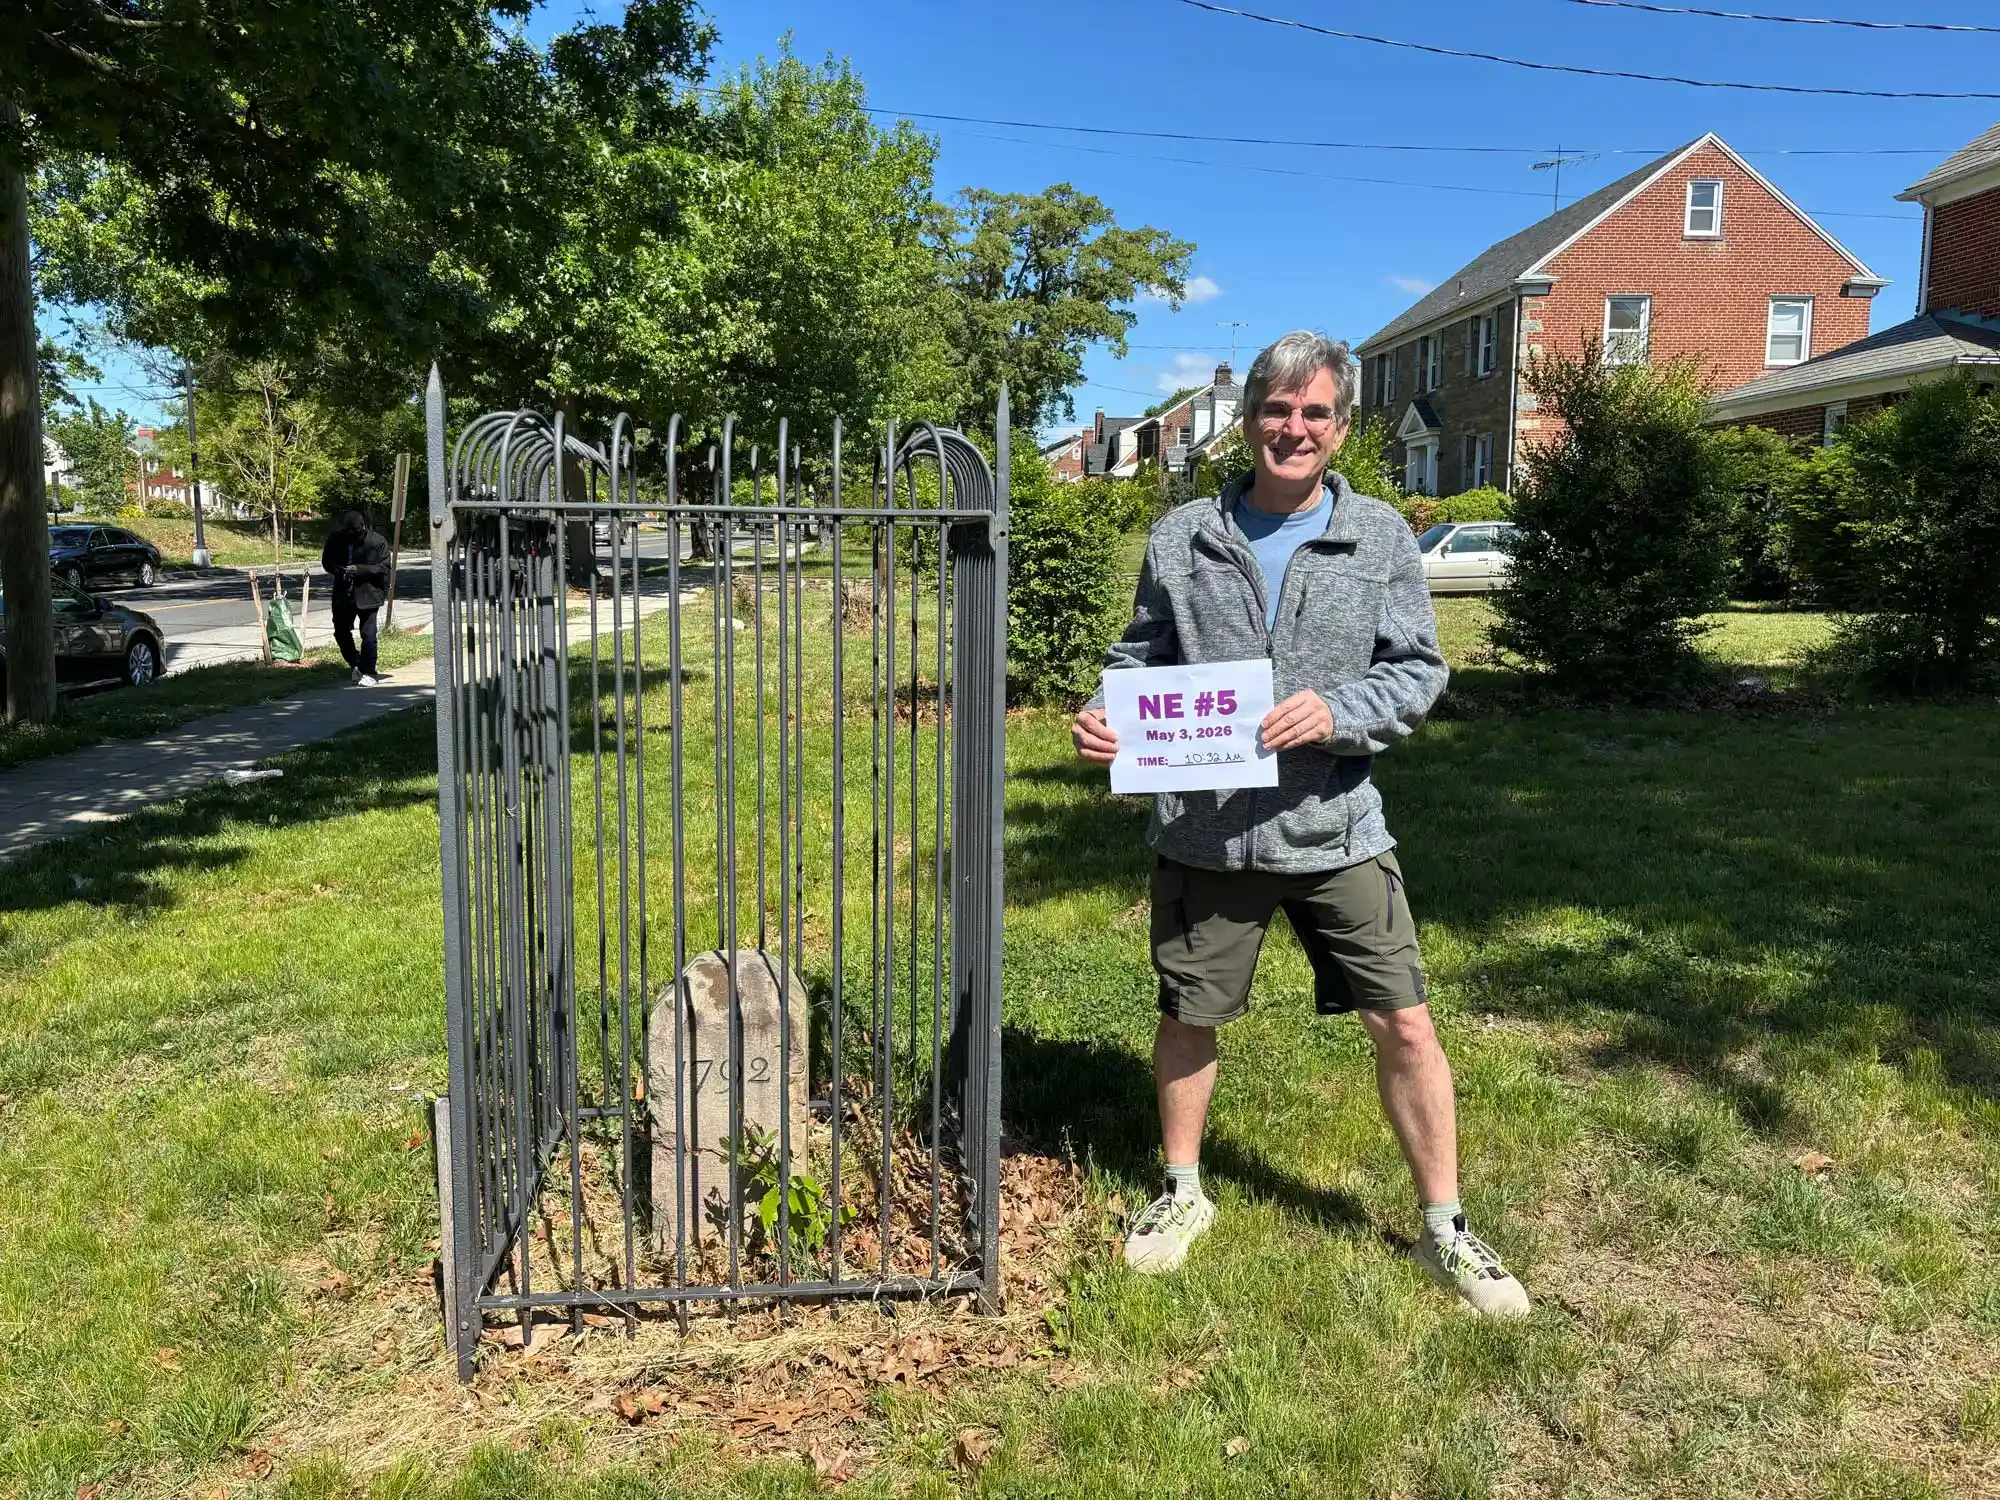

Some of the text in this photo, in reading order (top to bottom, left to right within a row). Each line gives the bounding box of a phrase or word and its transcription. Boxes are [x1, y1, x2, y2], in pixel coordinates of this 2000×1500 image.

[1138, 689, 1238, 720] NE #5
[1146, 725, 1232, 742] May 3, 2026
[1137, 756, 1169, 767] TIME:
[1184, 752, 1221, 764] 10:32
[682, 1056, 771, 1096] 792
